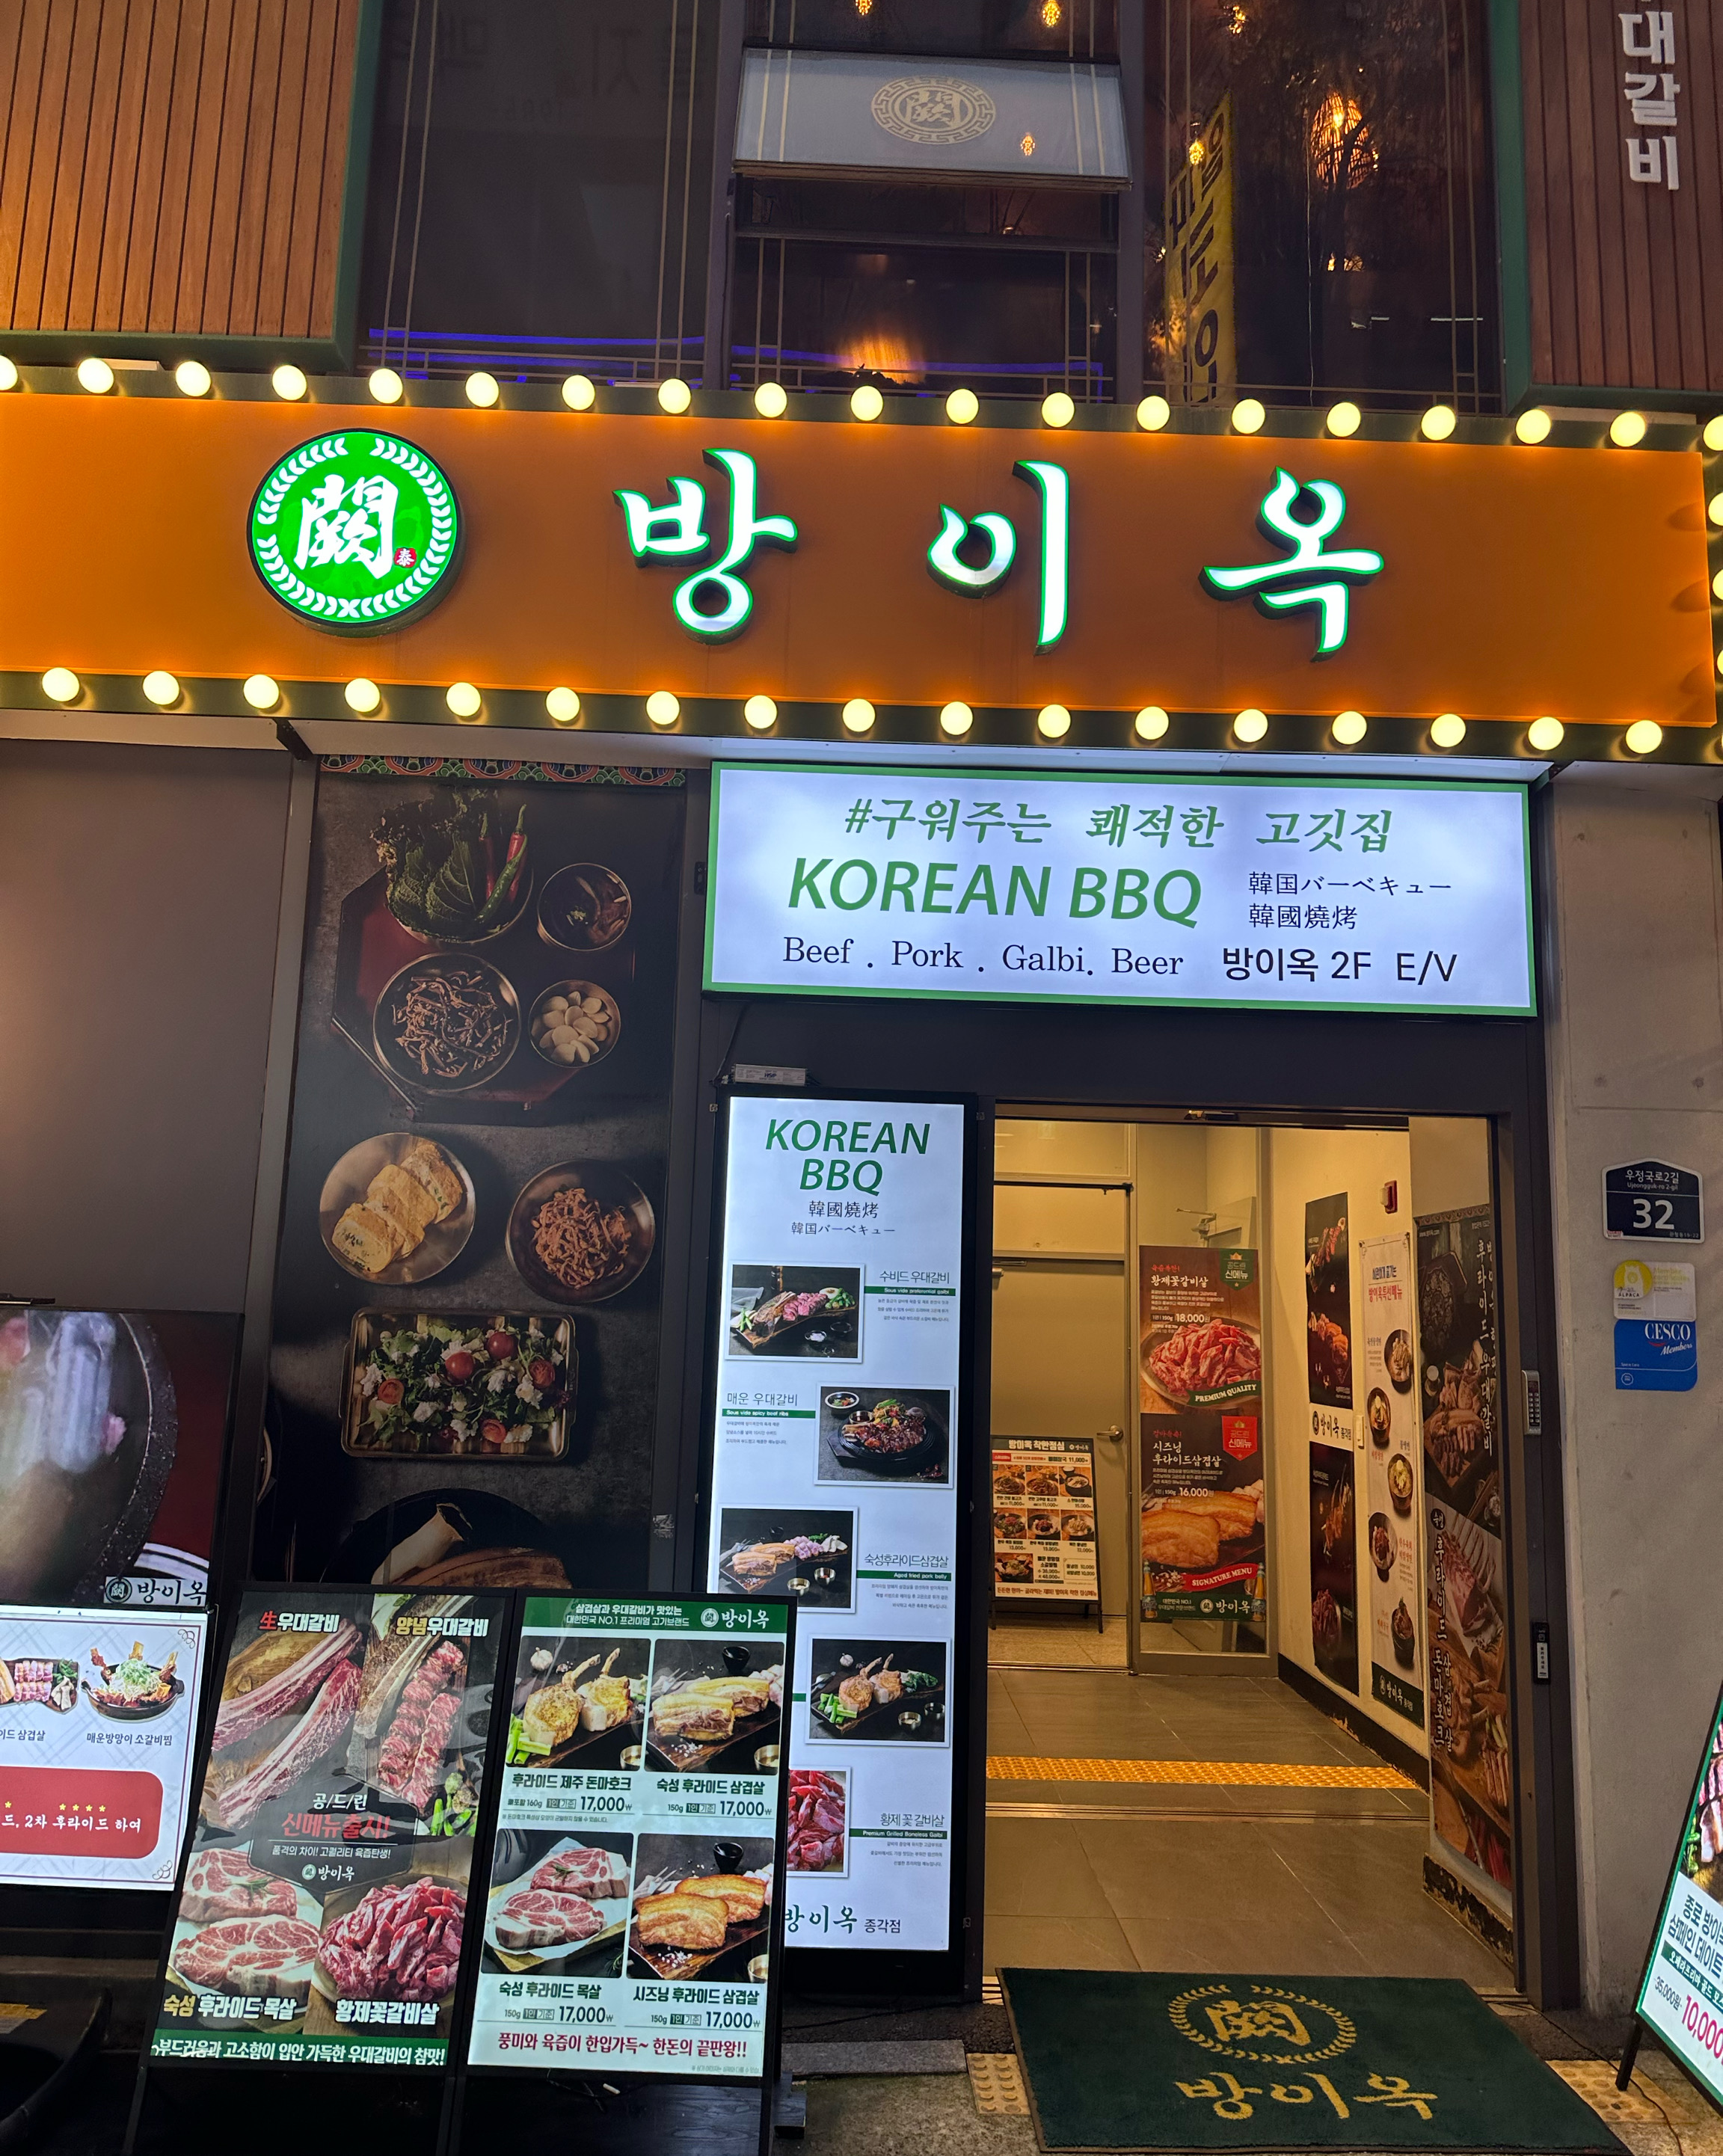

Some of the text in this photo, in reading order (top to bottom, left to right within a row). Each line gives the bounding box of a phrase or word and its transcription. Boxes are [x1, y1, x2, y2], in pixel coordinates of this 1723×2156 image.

[613, 449, 1384, 661] 방이옥
[845, 797, 1392, 855] #구워주는 쾌적한 고깃집
[787, 858, 1201, 929] KOREAN BBQ
[1247, 871, 1452, 897] 韓国バーベキュー
[1247, 902, 1358, 931] 韓國燒烤
[783, 936, 854, 965] Beef
[891, 941, 964, 969] Pork
[1111, 950, 1184, 975] Beer
[1221, 948, 1458, 983] 방이옥 2F E/V
[766, 1119, 930, 1155] KOREAN
[799, 1159, 883, 1197] BBQ
[1625, 1169, 1679, 1185] 우정국로2길
[1627, 1182, 1679, 1192] Ujeongguk-ro 2-gil
[808, 1200, 879, 1219] 韓國燒烤
[1633, 1197, 1675, 1230] 32
[791, 1222, 896, 1235] 韓国バーベキュー
[879, 1271, 950, 1284] 수비드 우대갈비
[1150, 1274, 1209, 1289] 황제꽃갈비살
[1225, 1270, 1249, 1280] 신메뉴
[1475, 1239, 1489, 1340] 후라이드
[1644, 1322, 1692, 1341] CESCO
[1659, 1341, 1694, 1356] Members
[727, 1392, 797, 1406] 매운 우대갈비
[1195, 1383, 1257, 1402] PREMIUM QUALITY
[1320, 1413, 1339, 1439] 방이옥
[1008, 1440, 1065, 1451] 방이옥 착한점심
[1152, 1441, 1182, 1453] 시즈닝
[1228, 1439, 1253, 1449] 신메뉴
[1152, 1453, 1223, 1467] 후라이드삼겹살
[864, 1554, 949, 1567] 숙성후라이드삼겹살
[1191, 1567, 1253, 1587] SIGNATURE MENU
[137, 1578, 207, 1606] 방이옥
[1434, 1536, 1447, 1639] 후라이드
[575, 1603, 683, 1617] 삼겹살과 우대갈비가 맛있는
[1214, 1599, 1250, 1614] 방이옥
[259, 1609, 340, 1633] 生우대갈비
[396, 1615, 490, 1637] 양념우대갈비
[566, 1615, 690, 1627] 대한민국 NO.1 프리미엄 고기브랜드
[721, 1609, 770, 1629] 방이옥
[18, 1730, 46, 1742] 삼겹살
[87, 1732, 173, 1746] 매운방망이 소갈비찜
[512, 1773, 632, 1791] 후라이드 제주 돈마호크
[657, 1778, 765, 1795] 숙성 후라이드 삼겹살
[526, 1799, 543, 1808] 160g
[667, 1804, 684, 1813] 150g
[25, 1814, 48, 1829] 2차
[52, 1815, 109, 1831] 후라이드
[114, 1817, 141, 1834] 하여
[880, 1813, 901, 1826] 황제
[914, 1814, 945, 1827] 갈비살
[271, 1844, 391, 1860] 품격의 차이! 고퀄리티 육즙탄생!
[318, 1867, 354, 1882] 방이옥
[784, 1903, 902, 1935] 방이옥 종각점
[1683, 1894, 1704, 1928] 종로
[499, 1982, 602, 2000] 숙성 후라이드 목살
[633, 1985, 760, 2006] 시즈닝 후라이드 삼겹살
[1701, 1977, 1713, 1997] 골드
[162, 1994, 298, 2021] 숙성 후라이드 목살
[335, 1998, 440, 2025] 황제꽃갈비살
[504, 2009, 521, 2019] 150g
[651, 2014, 668, 2025] 150g
[224, 2041, 275, 2061] 고소함이
[279, 2043, 305, 2062] 입안
[306, 2045, 346, 2063] 가득한
[348, 2045, 413, 2065] 우대갈비의
[414, 2047, 445, 2067] 참맛!
[498, 2032, 538, 2051] 풍미와
[541, 2033, 582, 2052] 육즙이
[652, 2038, 693, 2057] 한돈의
[696, 2040, 748, 2059] 끝판왕!!
[1173, 2071, 1439, 2122] 방이옥
